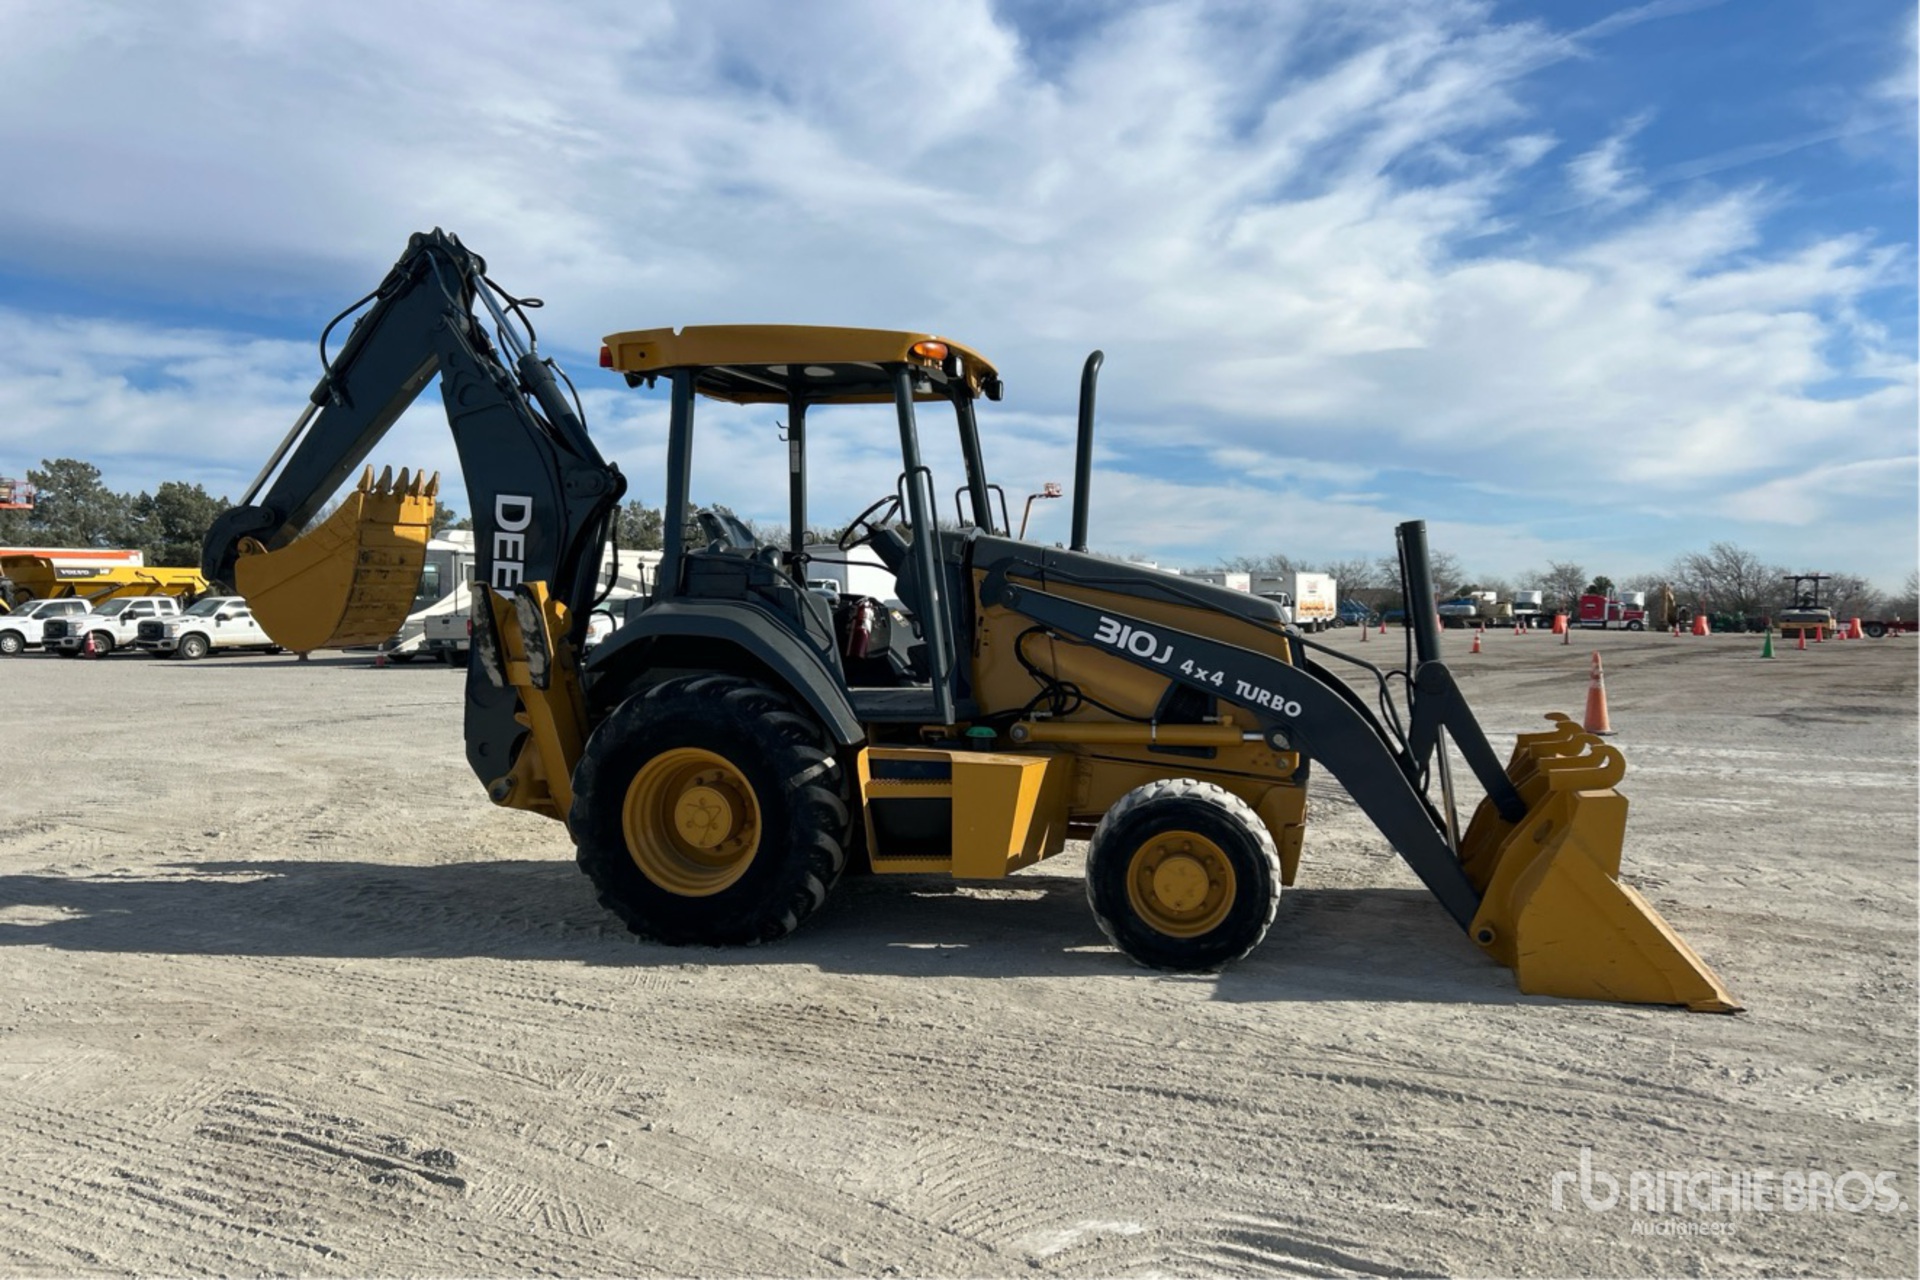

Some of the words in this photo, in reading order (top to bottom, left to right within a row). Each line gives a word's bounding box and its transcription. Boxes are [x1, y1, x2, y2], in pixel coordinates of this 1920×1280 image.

[1094, 616, 1174, 664] 310J
[1180, 659, 1225, 687] 4x4
[1235, 679, 1302, 718] TURBO
